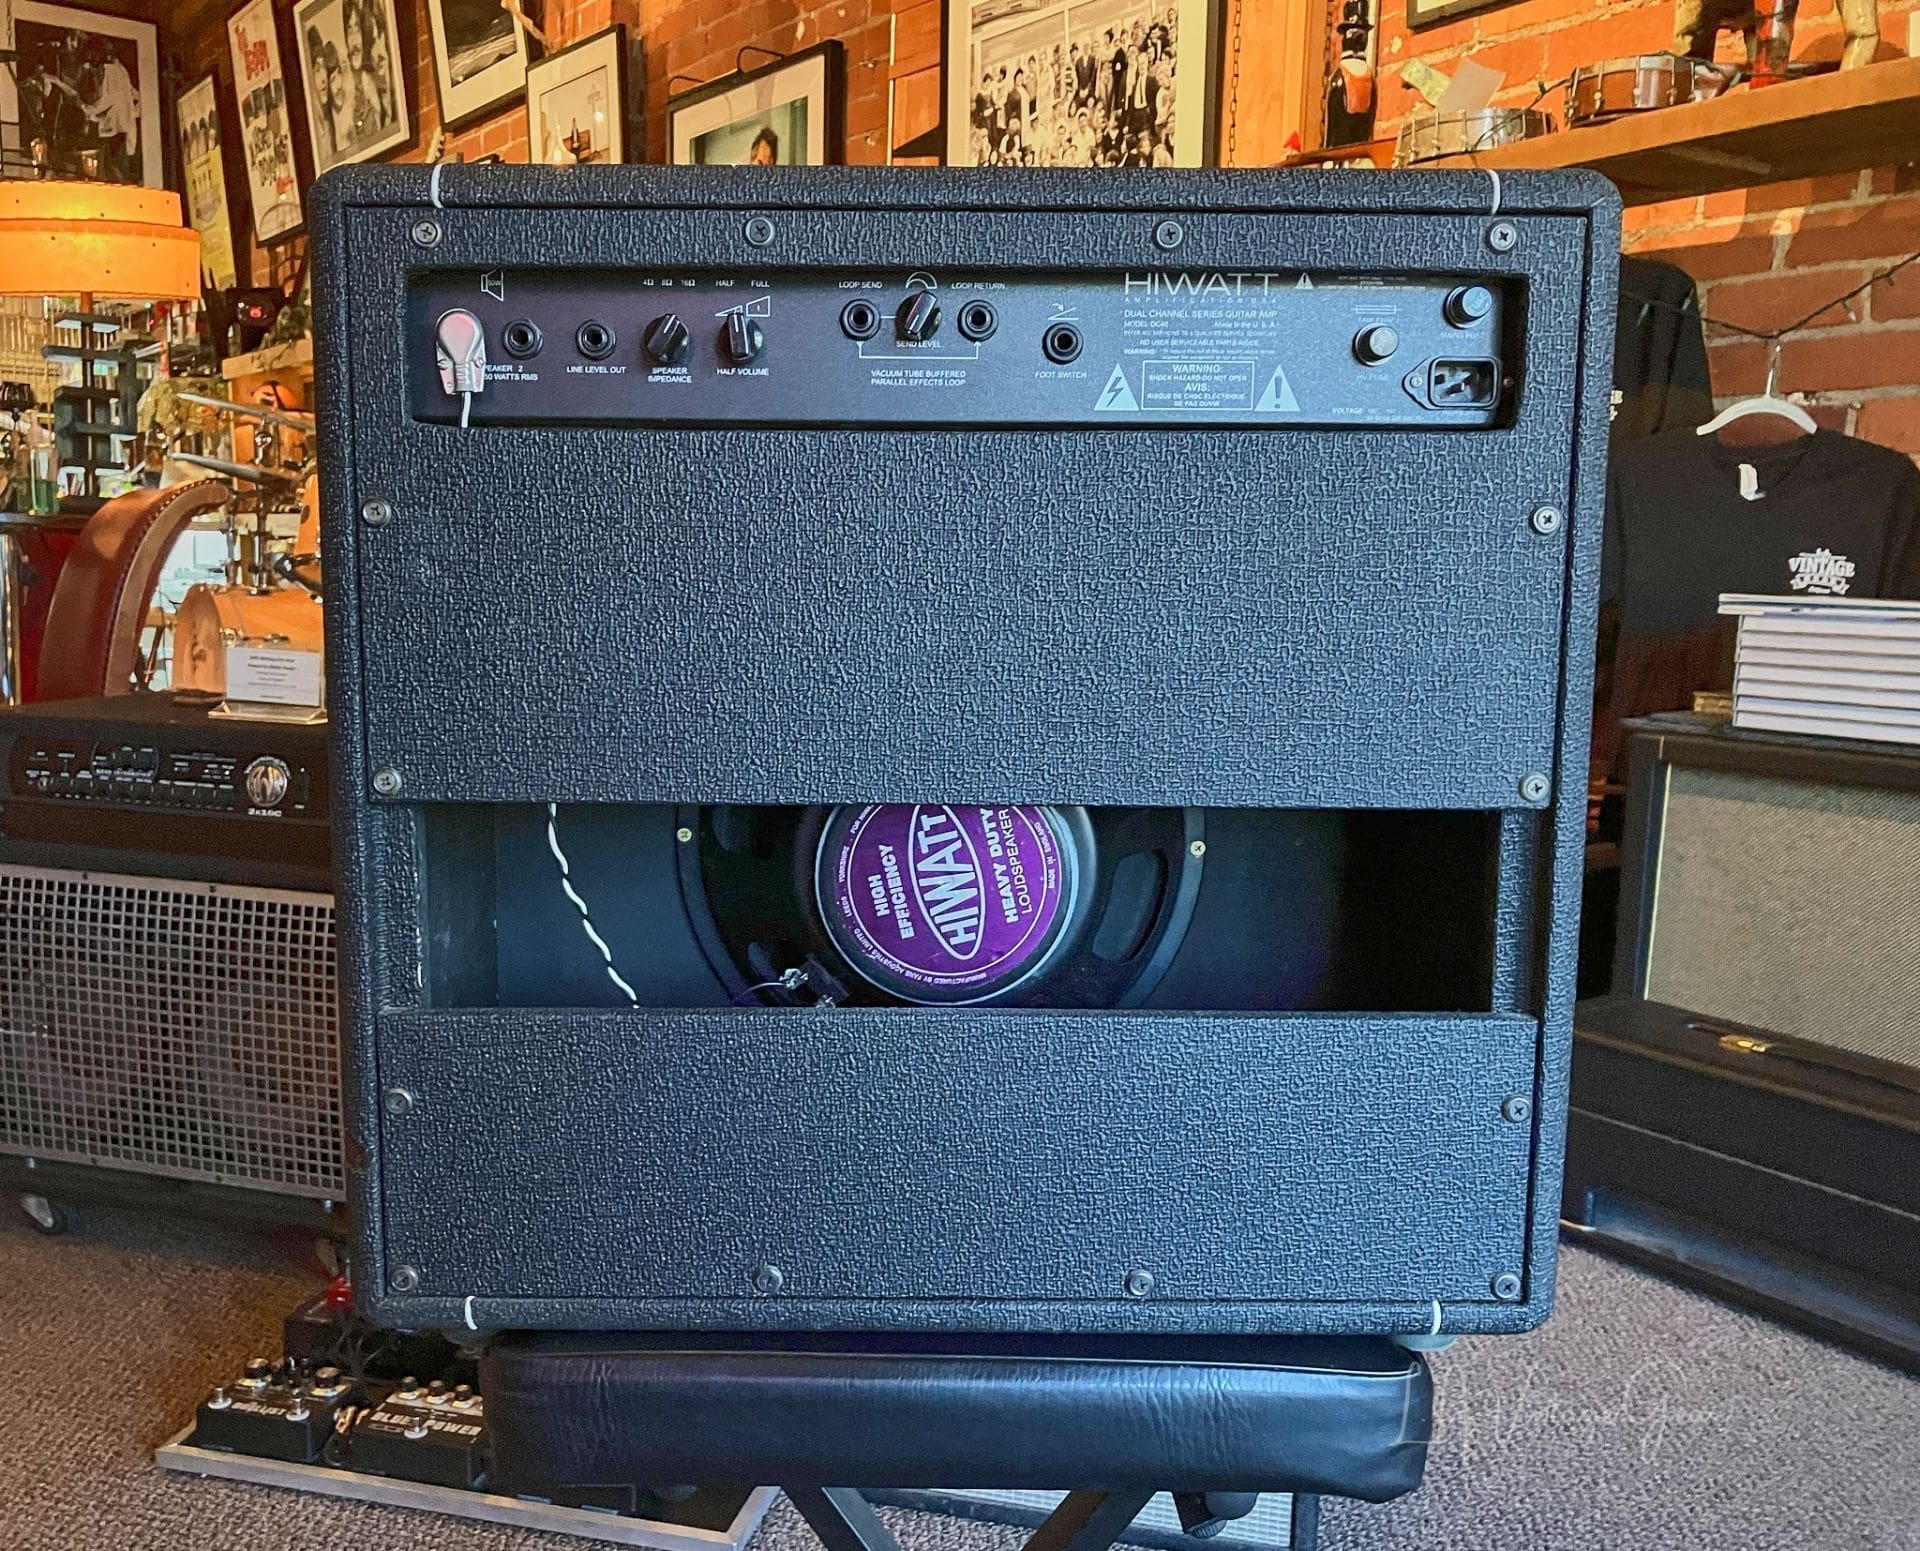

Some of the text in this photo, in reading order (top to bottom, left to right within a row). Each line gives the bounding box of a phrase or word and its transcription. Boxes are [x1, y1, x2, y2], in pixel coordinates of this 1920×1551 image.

[838, 281, 882, 289] LOOP SEND
[952, 282, 1006, 290] LOOP RETURN
[1124, 272, 1279, 296] HIWATT
[1124, 310, 1147, 318] DUAL
[1149, 310, 1188, 318] CHANNEL
[1191, 310, 1223, 318] SERIES
[1225, 311, 1256, 319] GUITAR
[1123, 320, 1148, 328] MODEL
[484, 364, 524, 373] PEAKER 2
[566, 366, 626, 374] LINE LEVEL OUT
[652, 367, 688, 375] SPEAKER
[716, 368, 770, 376] HALF VOLUME
[1172, 364, 1224, 373] WARNING:
[493, 373, 520, 381] WATTS
[521, 373, 539, 381] RMS
[871, 370, 966, 378] VACUUM TUBE BUFFERED
[1035, 371, 1087, 379] FOOT SWITCH
[648, 376, 692, 384] IMPEDANCE
[871, 378, 966, 386] PARALLEL EFFECTS LOOP
[1184, 383, 1211, 392] AVIS:
[1788, 557, 1856, 578] VINTAGE
[1034, 821, 1050, 853] ENGLAND
[980, 808, 1019, 924] HEAVY DUTY
[998, 809, 1033, 914] LOUDSPEAKER
[917, 814, 980, 946] HIWATT
[868, 874, 890, 917] HIGH
[879, 844, 915, 940] EFFICIENCY
[854, 927, 873, 951] LIMITED
[905, 970, 923, 981] FANE
[922, 974, 934, 983] BY
[422, 1419, 482, 1436] POWER
